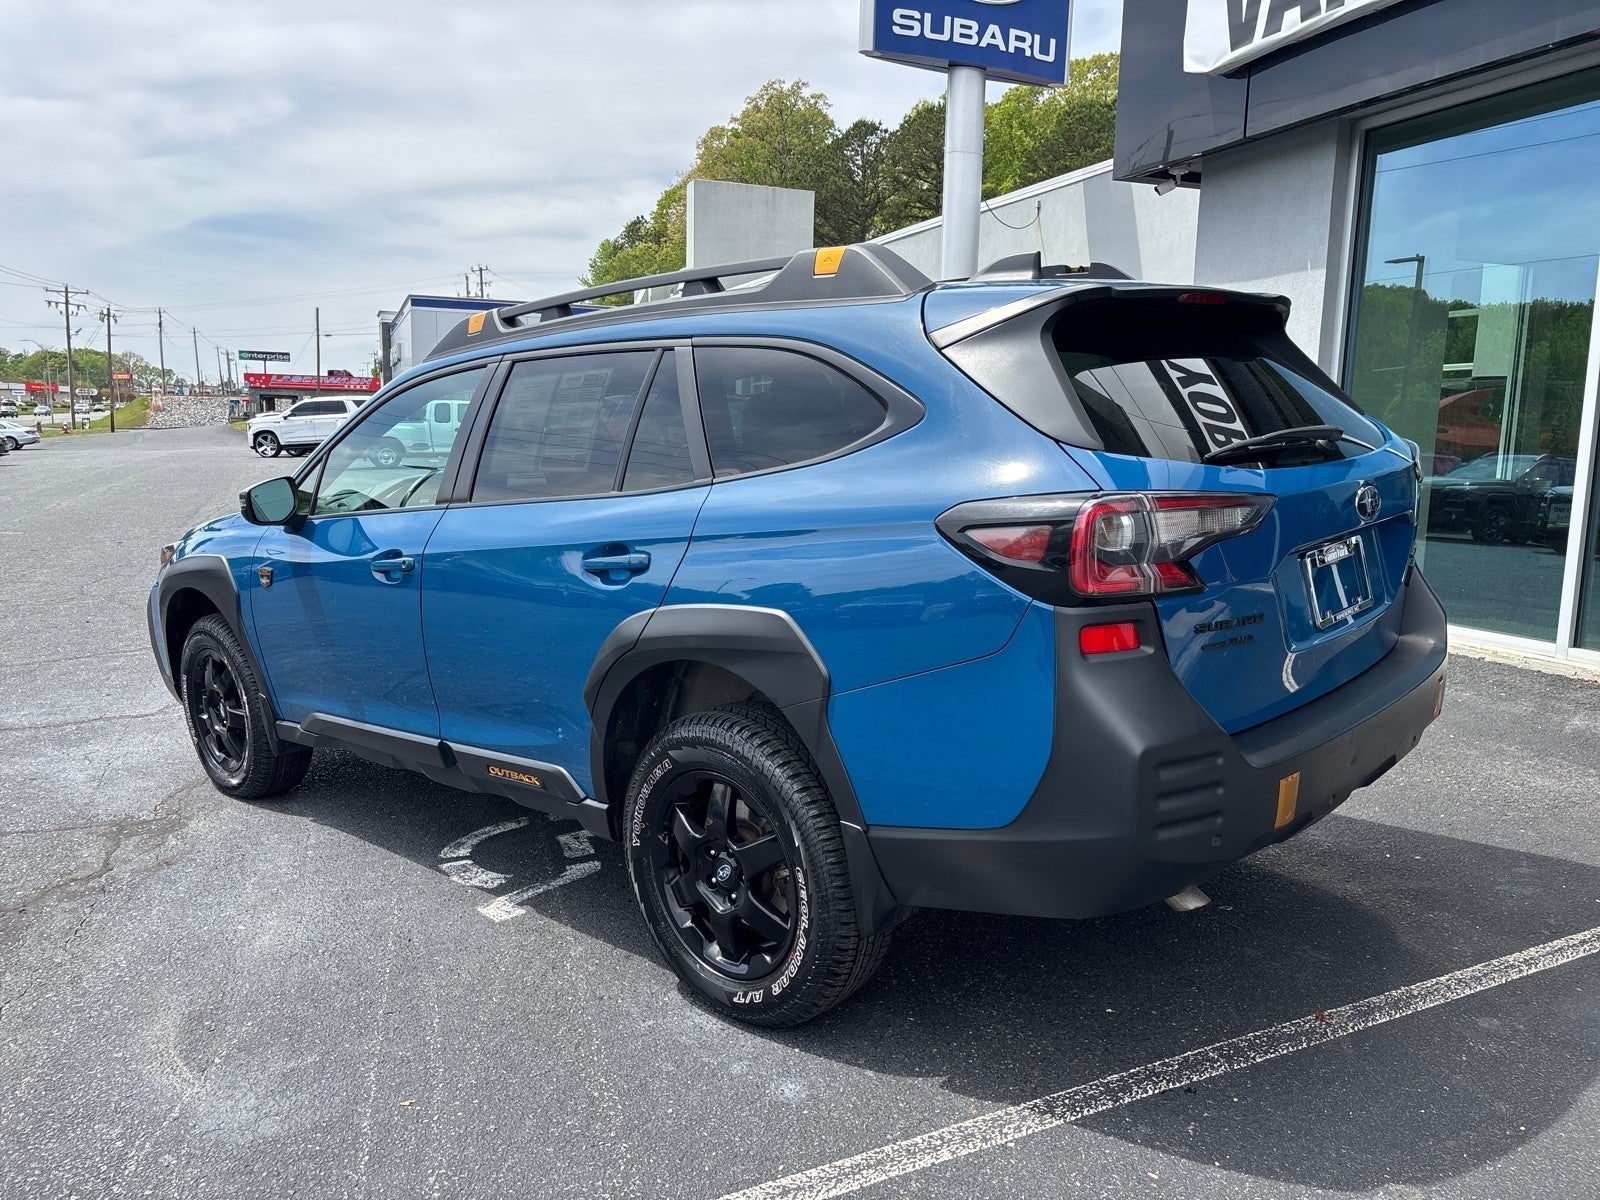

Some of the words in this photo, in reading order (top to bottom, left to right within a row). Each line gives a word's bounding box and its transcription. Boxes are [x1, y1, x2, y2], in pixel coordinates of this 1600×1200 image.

[892, 8, 1056, 63] SUBARU
[240, 352, 290, 361] enterprise
[1193, 612, 1265, 635] SUBARU
[488, 765, 540, 786] OUTBACK
[632, 758, 672, 847] YOKOHAMA
[772, 866, 808, 996] GEOLANDAR
[733, 990, 764, 1004] A/T
